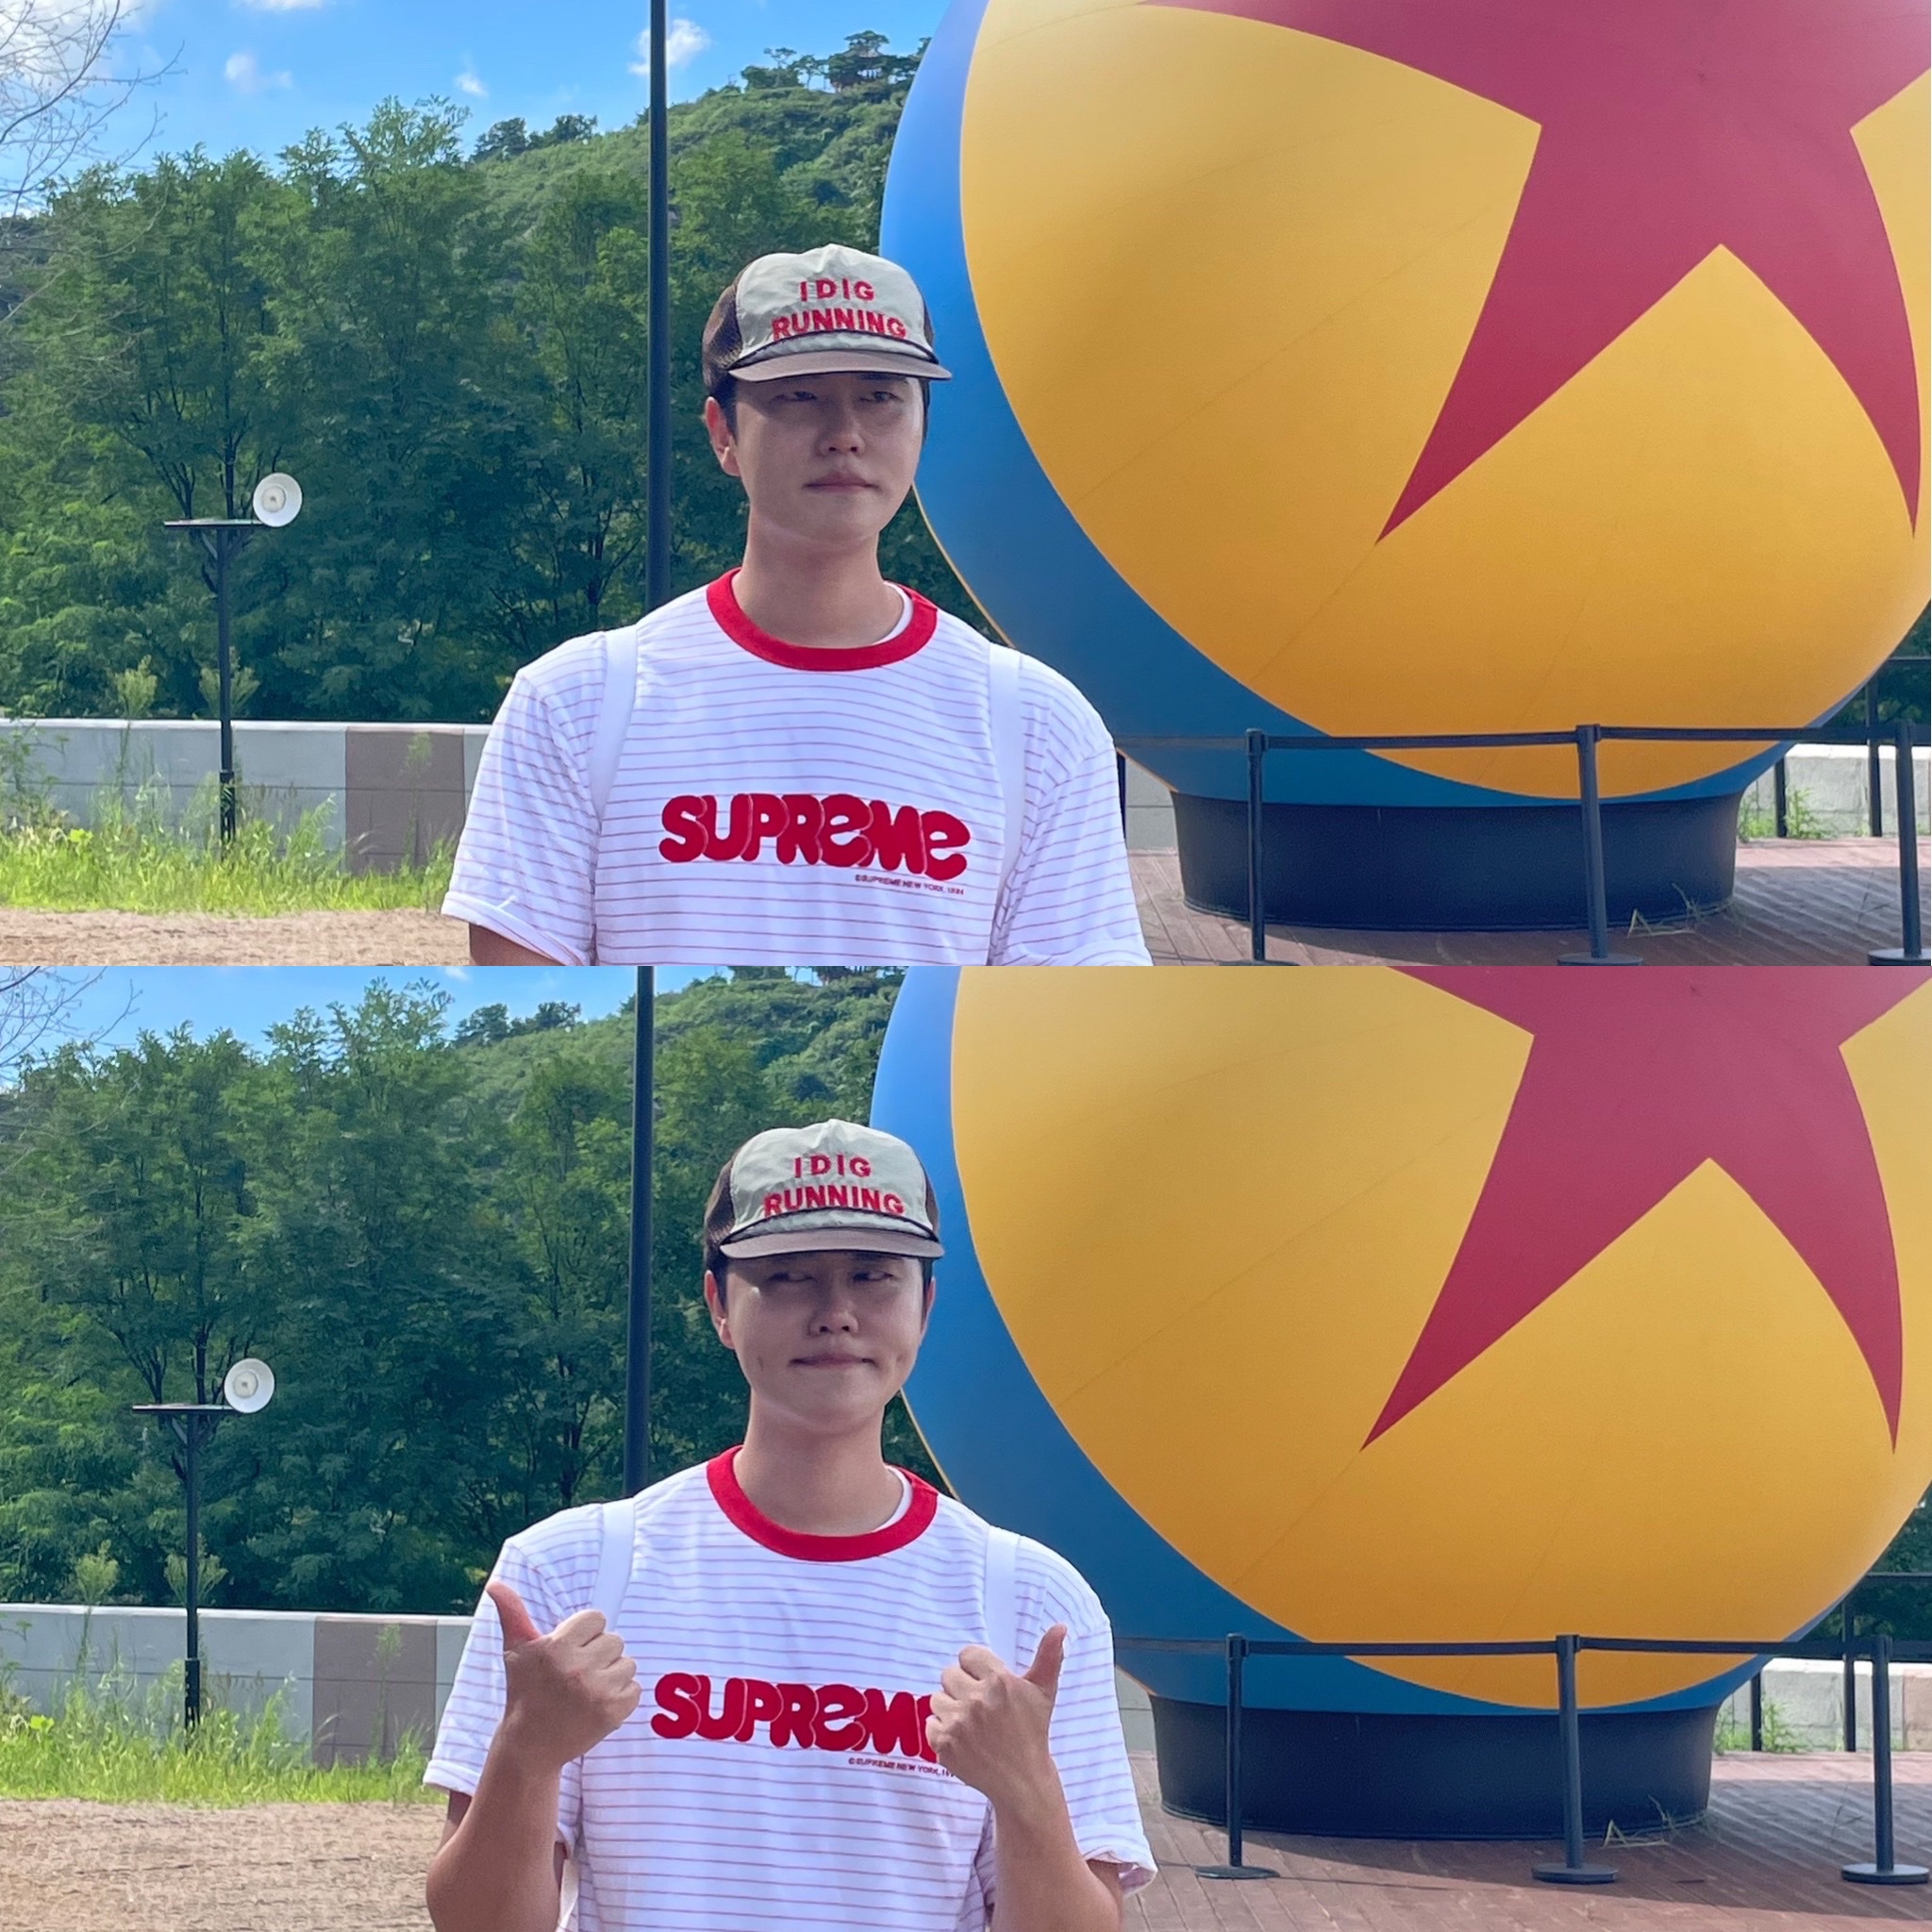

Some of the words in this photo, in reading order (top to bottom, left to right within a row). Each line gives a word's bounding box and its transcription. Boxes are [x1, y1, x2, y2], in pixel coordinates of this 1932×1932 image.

[816, 278, 875, 301] DIG
[771, 308, 908, 341] RUNNING
[903, 880, 922, 889] NEW
[810, 1154, 872, 1177] DIG
[763, 1186, 907, 1217] RUNNING
[896, 1762, 916, 1772] NEW
